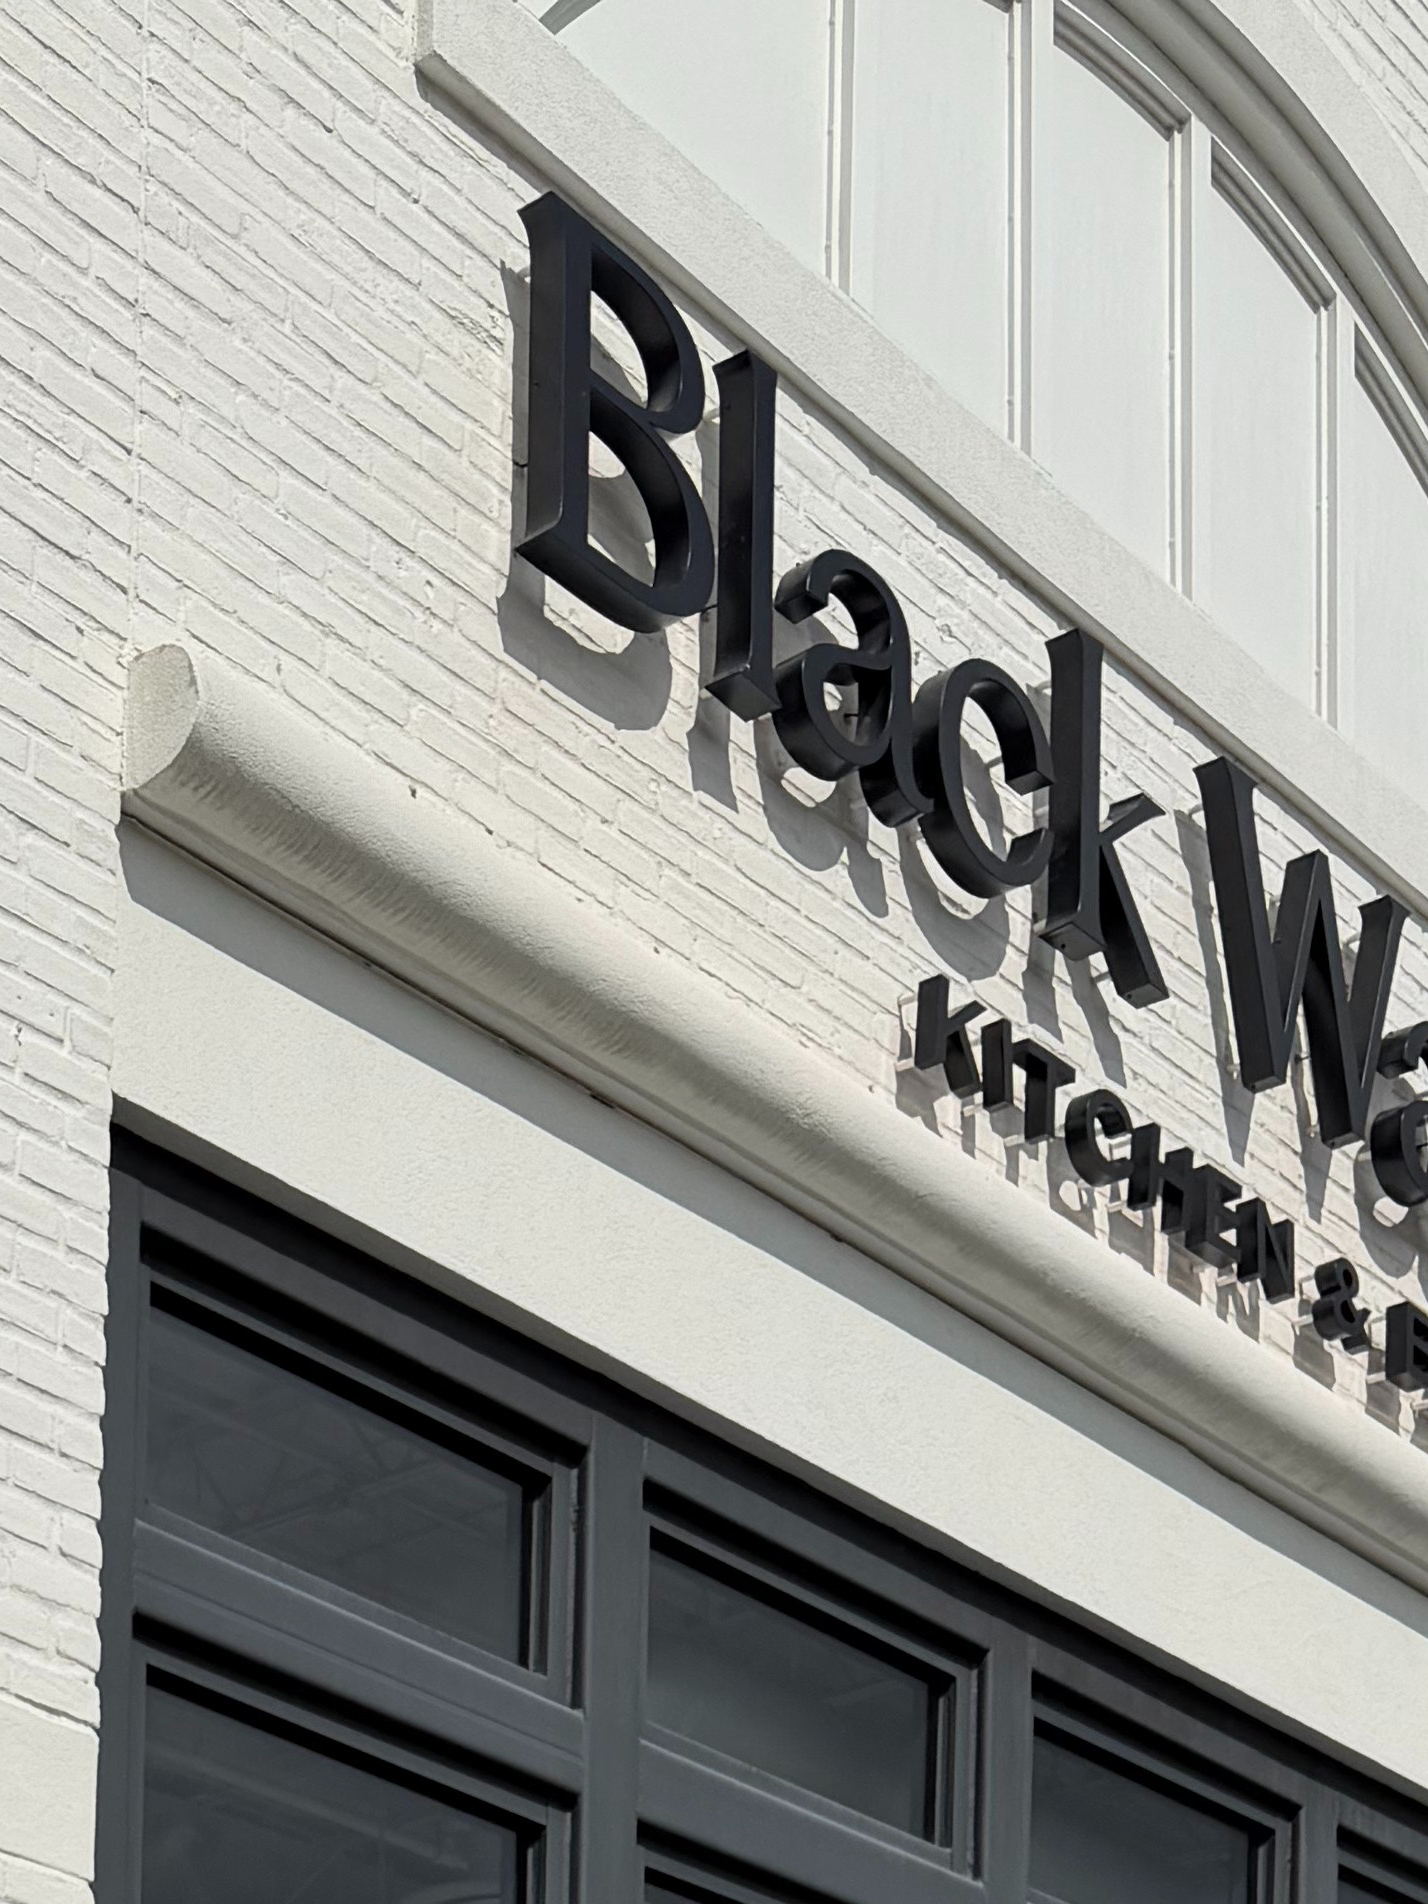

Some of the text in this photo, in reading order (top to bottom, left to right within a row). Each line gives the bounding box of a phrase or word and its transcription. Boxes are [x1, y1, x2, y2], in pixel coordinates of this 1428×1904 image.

[515, 189, 1169, 1009] Black
[914, 973, 1295, 1304] KITCHEN
[1312, 1257, 1370, 1354] &
